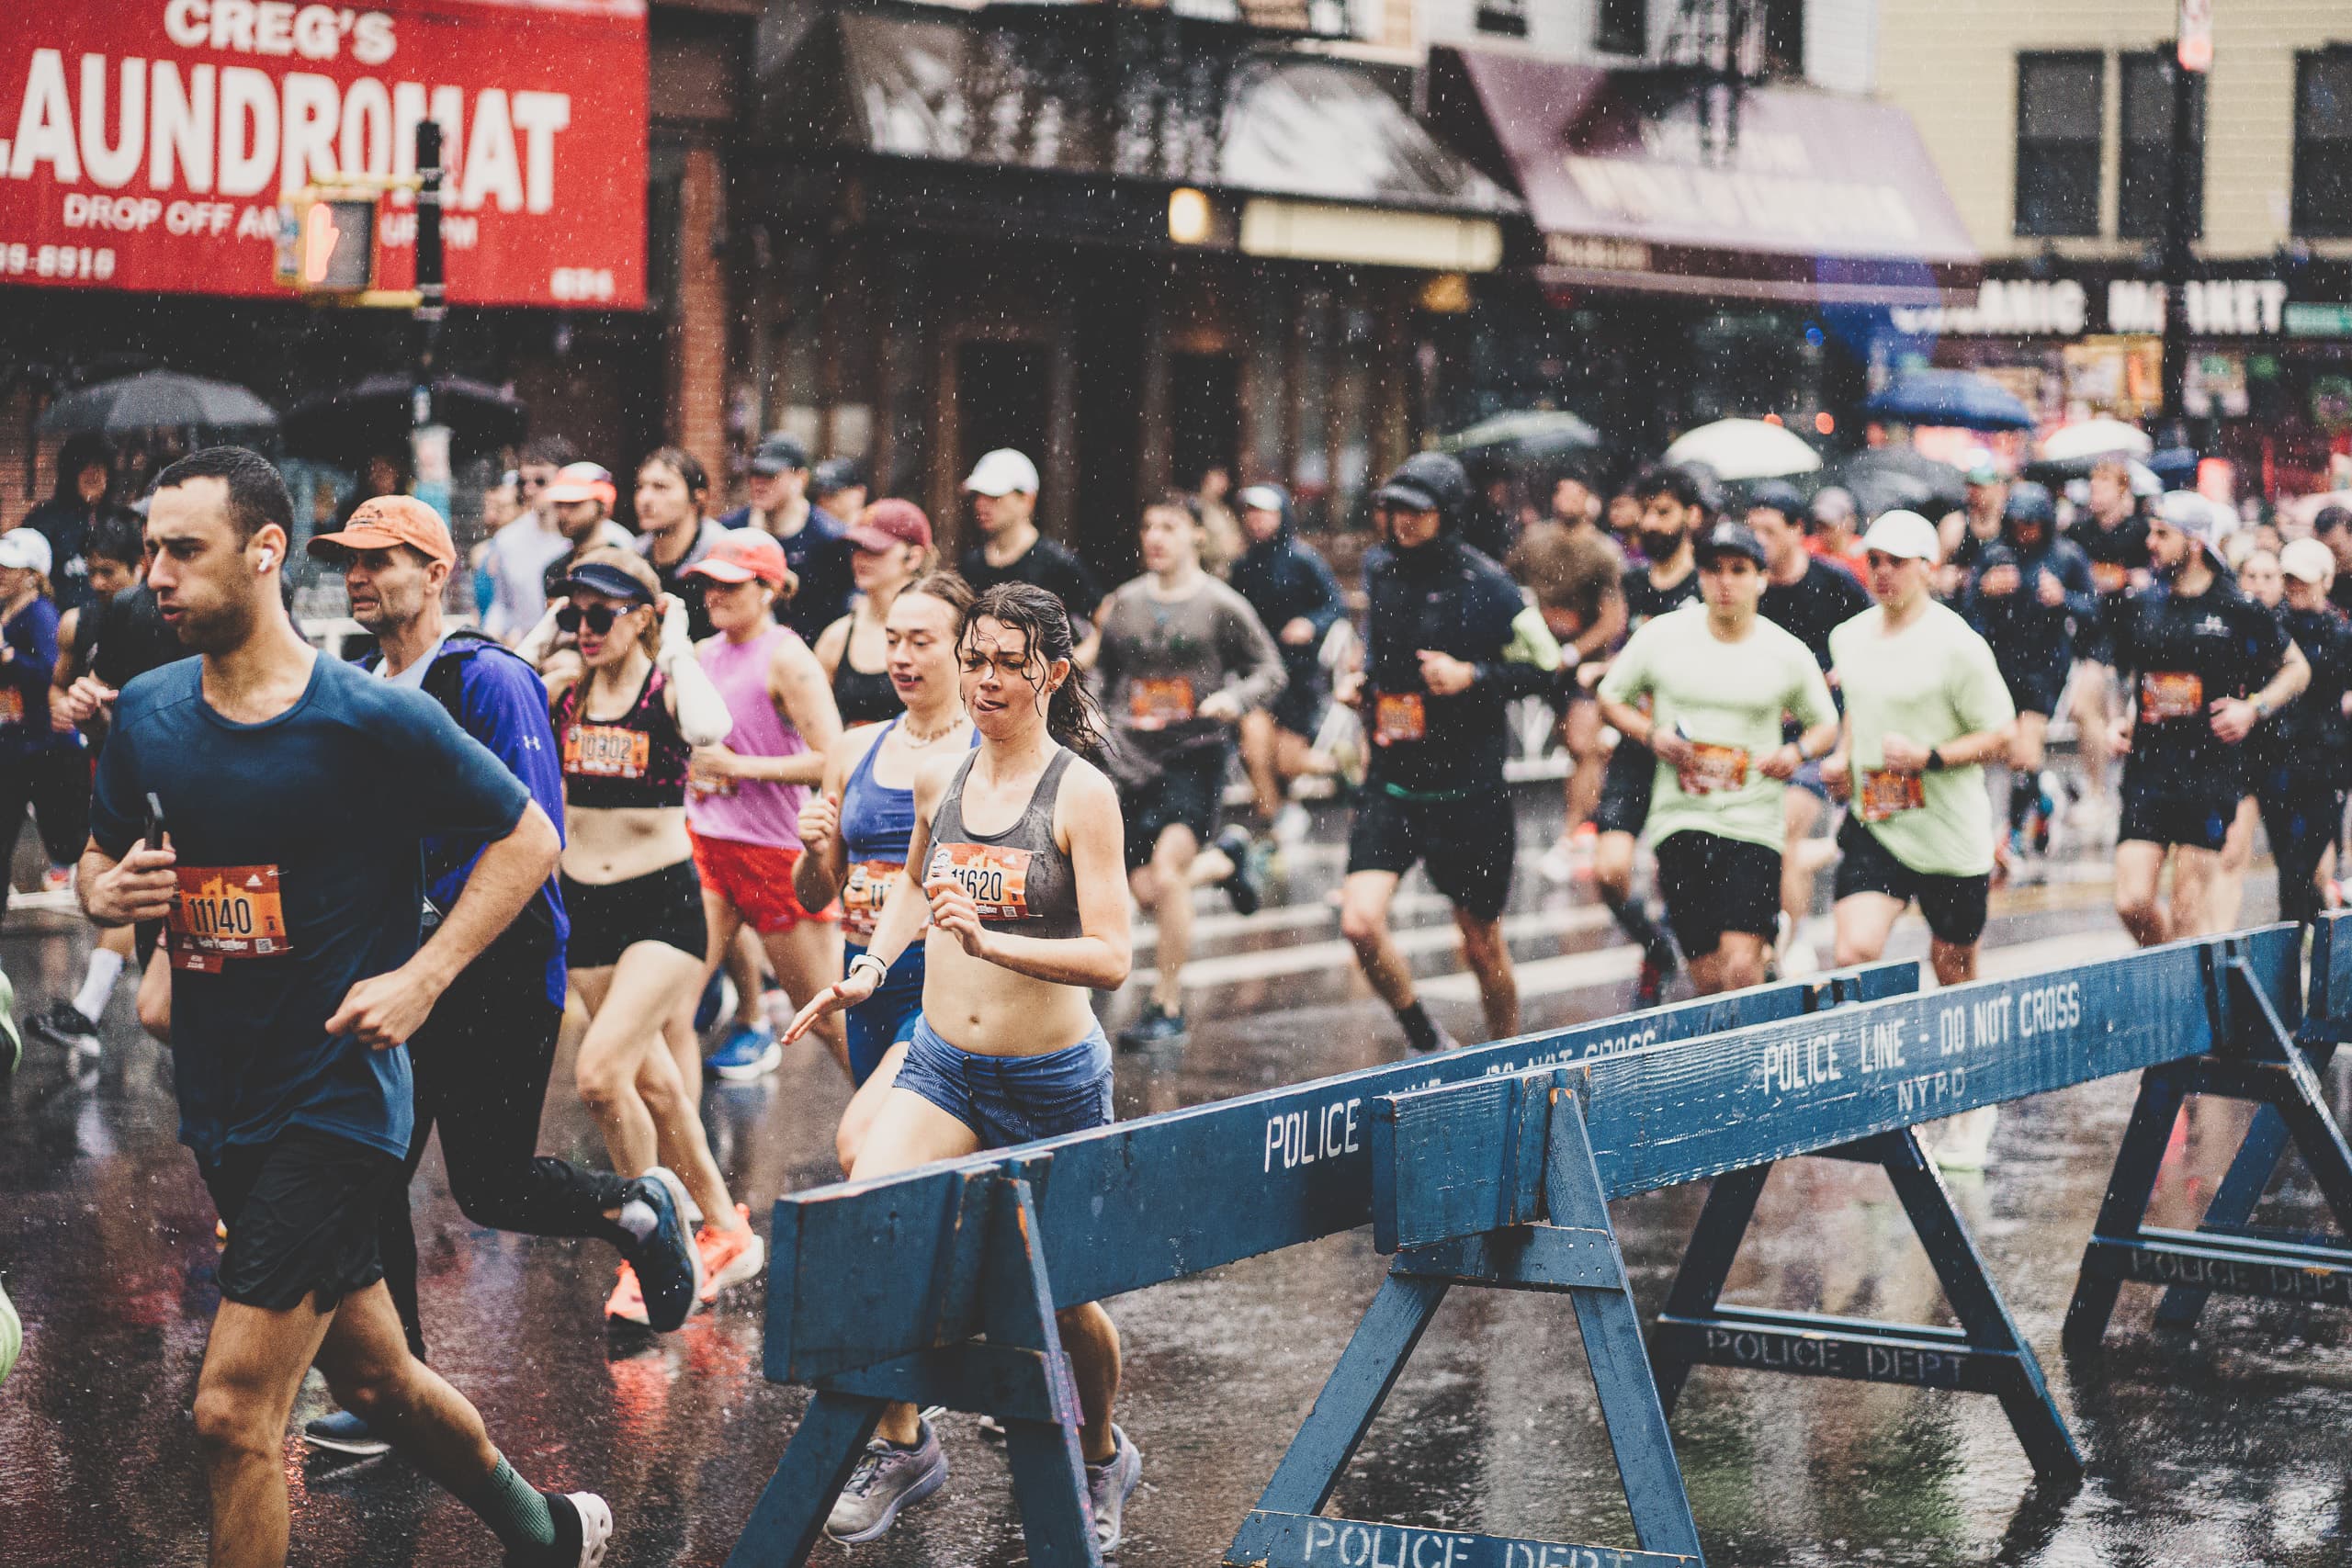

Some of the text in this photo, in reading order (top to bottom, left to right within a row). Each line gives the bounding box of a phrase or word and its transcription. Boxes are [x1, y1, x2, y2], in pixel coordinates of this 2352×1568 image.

[164, 0, 397, 65] CREG'S
[0, 48, 571, 214] AUNDROMAT
[63, 193, 162, 232] DROP
[165, 200, 234, 236] OFF
[236, 205, 279, 239] AN
[952, 868, 1001, 901] 1620
[188, 897, 252, 935] 11140
[1762, 1032, 1841, 1095] POLICE
[1860, 1018, 1906, 1074] LINE
[1940, 1005, 1965, 1055] DO
[1974, 995, 2012, 1047] NOT
[2020, 981, 2080, 1037] CROSS
[1897, 1067, 1966, 1112] NYPD
[1264, 1098, 1361, 1173] POLICE
[1706, 1329, 1969, 1382] POLICE DEPT
[1305, 1521, 1474, 1568] POLICE
